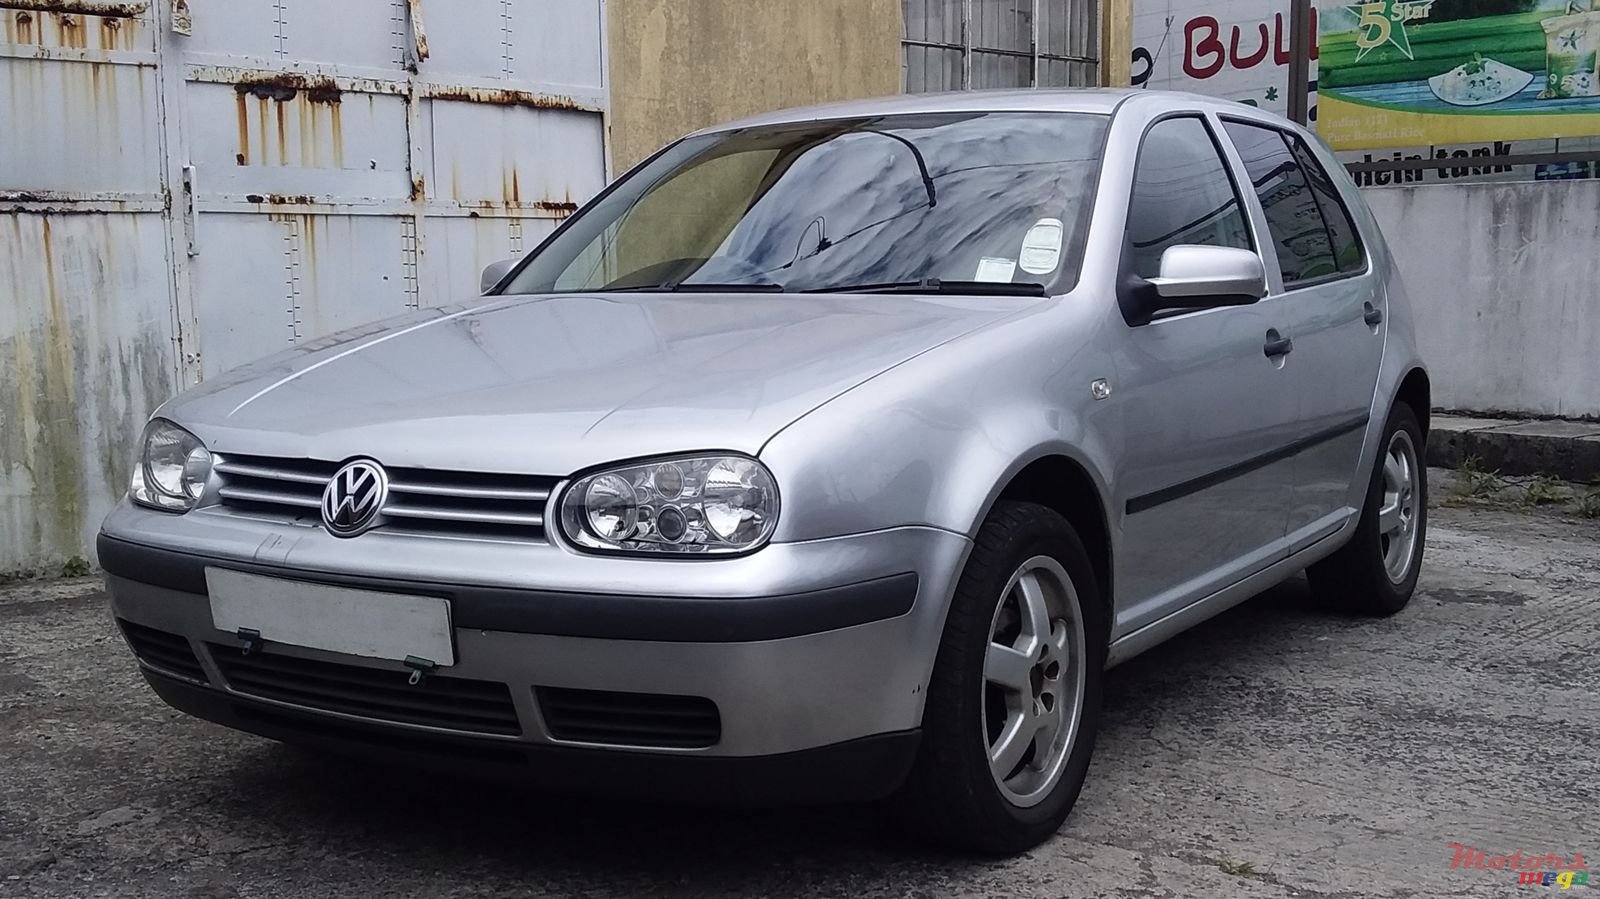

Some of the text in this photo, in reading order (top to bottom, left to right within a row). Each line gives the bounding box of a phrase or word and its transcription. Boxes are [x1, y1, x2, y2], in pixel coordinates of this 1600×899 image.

[1357, 2, 1432, 48] 5 Star
[1435, 141, 1513, 179] tank
